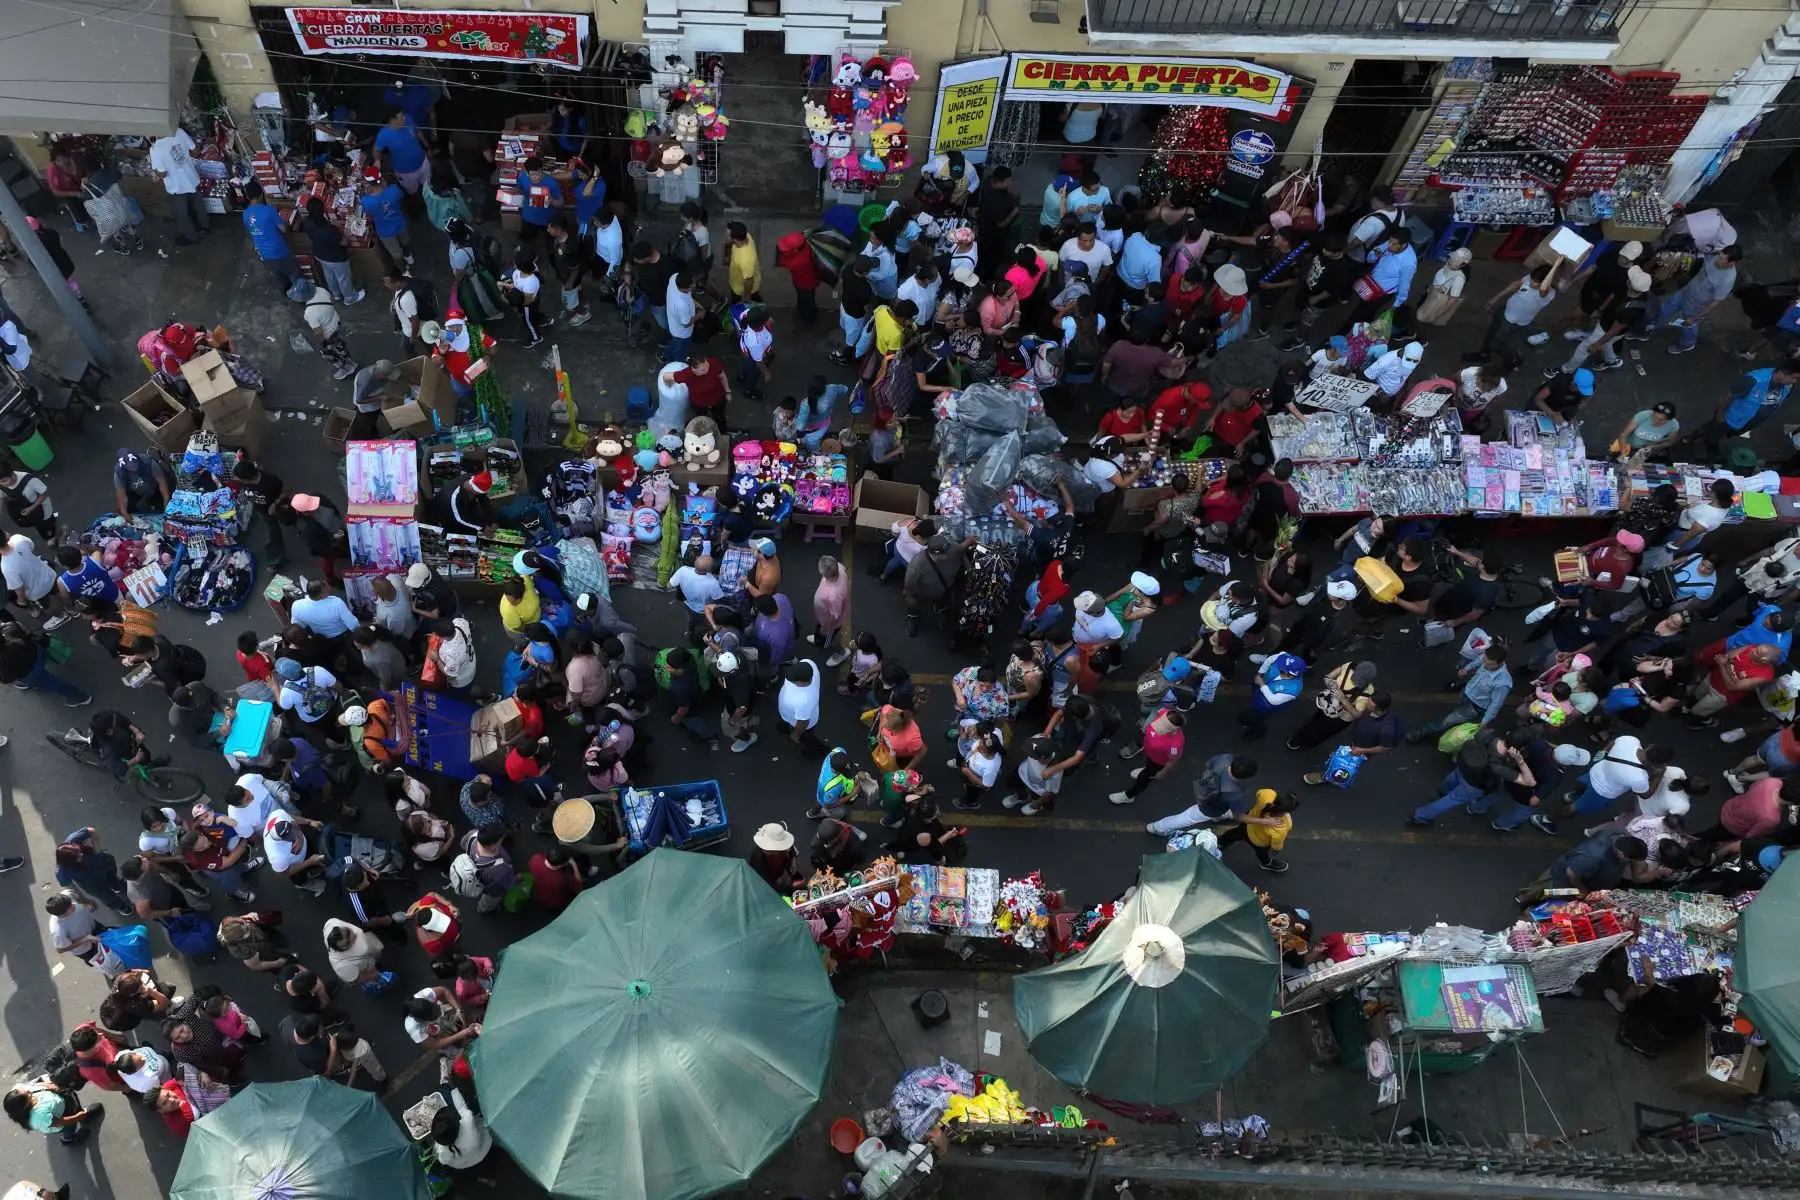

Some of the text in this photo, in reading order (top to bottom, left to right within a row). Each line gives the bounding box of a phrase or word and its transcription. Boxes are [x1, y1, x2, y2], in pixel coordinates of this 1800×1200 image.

[345, 14, 381, 24] GRAN
[307, 24, 444, 35] CIERRA PUERTAS
[1023, 61, 1271, 92] CIERRA PUERTAS
[957, 84, 985, 98] DESDE
[948, 96, 988, 113] UNA PIEZA
[947, 109, 984, 125] A PRECIO
[957, 124, 970, 135] DE
[938, 134, 983, 151] MAYORISTA
[1136, 679, 1157, 695] adidas
